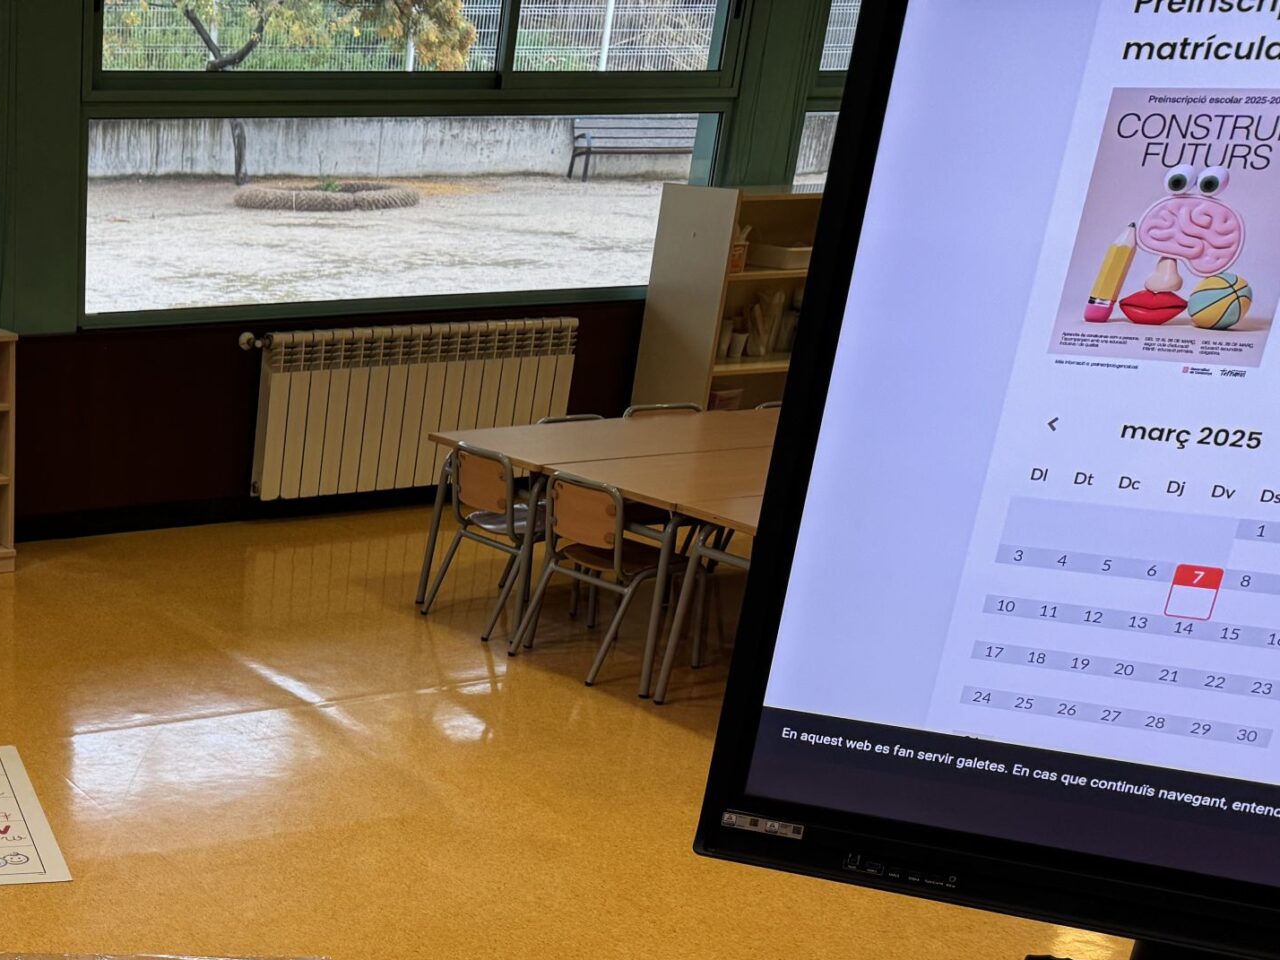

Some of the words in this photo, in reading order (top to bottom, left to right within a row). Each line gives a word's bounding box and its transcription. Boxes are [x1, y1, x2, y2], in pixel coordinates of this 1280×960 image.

[1134, 0, 1280, 20] Preinscri
[1148, 95, 1206, 105] Preinscripció
[1209, 96, 1243, 104] escolar
[1141, 142, 1273, 170] FUTURS
[1121, 425, 1190, 449] març
[1197, 427, 1262, 449] 2025
[1031, 468, 1048, 481] Dl
[1074, 472, 1094, 485] Dt
[1119, 476, 1140, 489] Dc
[1167, 481, 1185, 496] Dj
[1212, 485, 1235, 499] Dv
[1257, 525, 1264, 537] 1
[1014, 550, 1023, 561] 3
[1057, 555, 1066, 566] 4
[1102, 560, 1112, 571] 5
[1147, 565, 1156, 576] 6
[1193, 571, 1204, 583] 7
[1241, 575, 1251, 587] 8
[998, 600, 1015, 612] 10
[1040, 605, 1056, 618] 11
[1084, 611, 1102, 623] 12
[1129, 616, 1148, 628] 13
[1174, 622, 1193, 634] 14
[1220, 628, 1240, 640] 15
[1268, 633, 1280, 646] 1
[986, 646, 1004, 658] 17
[1028, 652, 1045, 664] 18
[1071, 658, 1089, 669] 19
[1114, 663, 1134, 675] 20
[1159, 669, 1177, 682] 21
[1204, 675, 1225, 688] 22
[1251, 682, 1272, 694] 23
[973, 691, 990, 703] 24
[1014, 697, 1034, 709] 25
[1057, 703, 1076, 716] 26
[1101, 710, 1121, 721] 27
[1145, 716, 1165, 728] 28
[1190, 723, 1211, 735] 29
[1237, 729, 1257, 742] 30
[782, 728, 797, 739] En
[800, 733, 843, 746] aquest
[846, 740, 871, 750] web
[875, 745, 889, 754] es
[894, 745, 914, 758] fan
[917, 752, 954, 764] servir
[956, 758, 1007, 773] galetes.
[1013, 764, 1029, 776] En
[1033, 770, 1057, 781] cas
[1061, 774, 1087, 785] que
[1091, 779, 1155, 796] continuïs
[1159, 790, 1227, 810] navegant,
